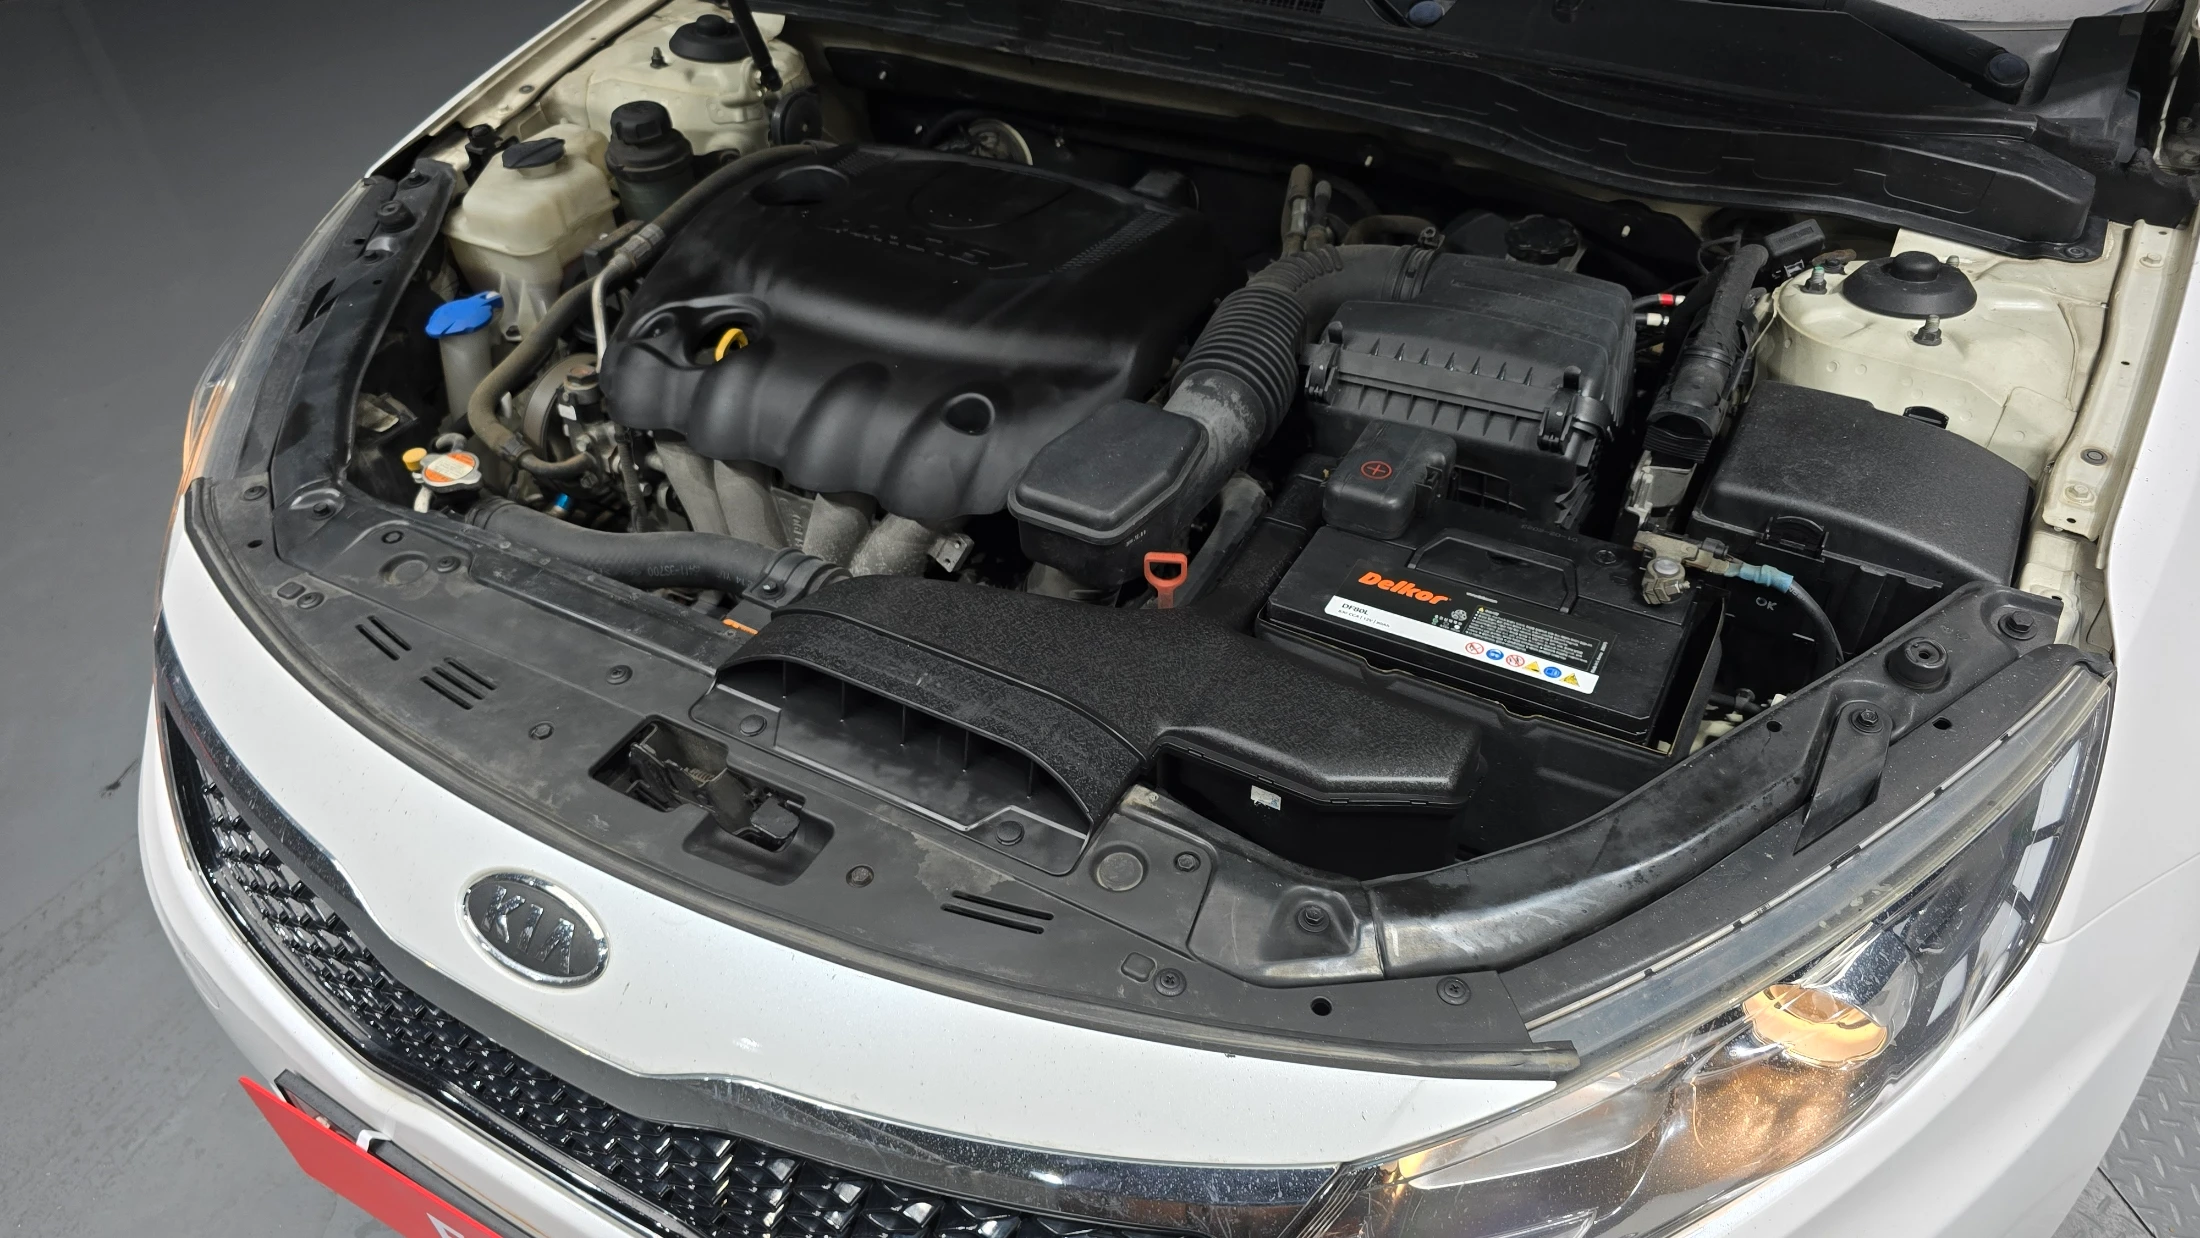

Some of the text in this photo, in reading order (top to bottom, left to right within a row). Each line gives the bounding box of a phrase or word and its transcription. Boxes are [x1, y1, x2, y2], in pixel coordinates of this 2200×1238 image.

[1358, 572, 1449, 605] Delkor
[1341, 603, 1369, 615] DF80L
[1756, 597, 1777, 611] OK
[480, 884, 575, 975] KIA
